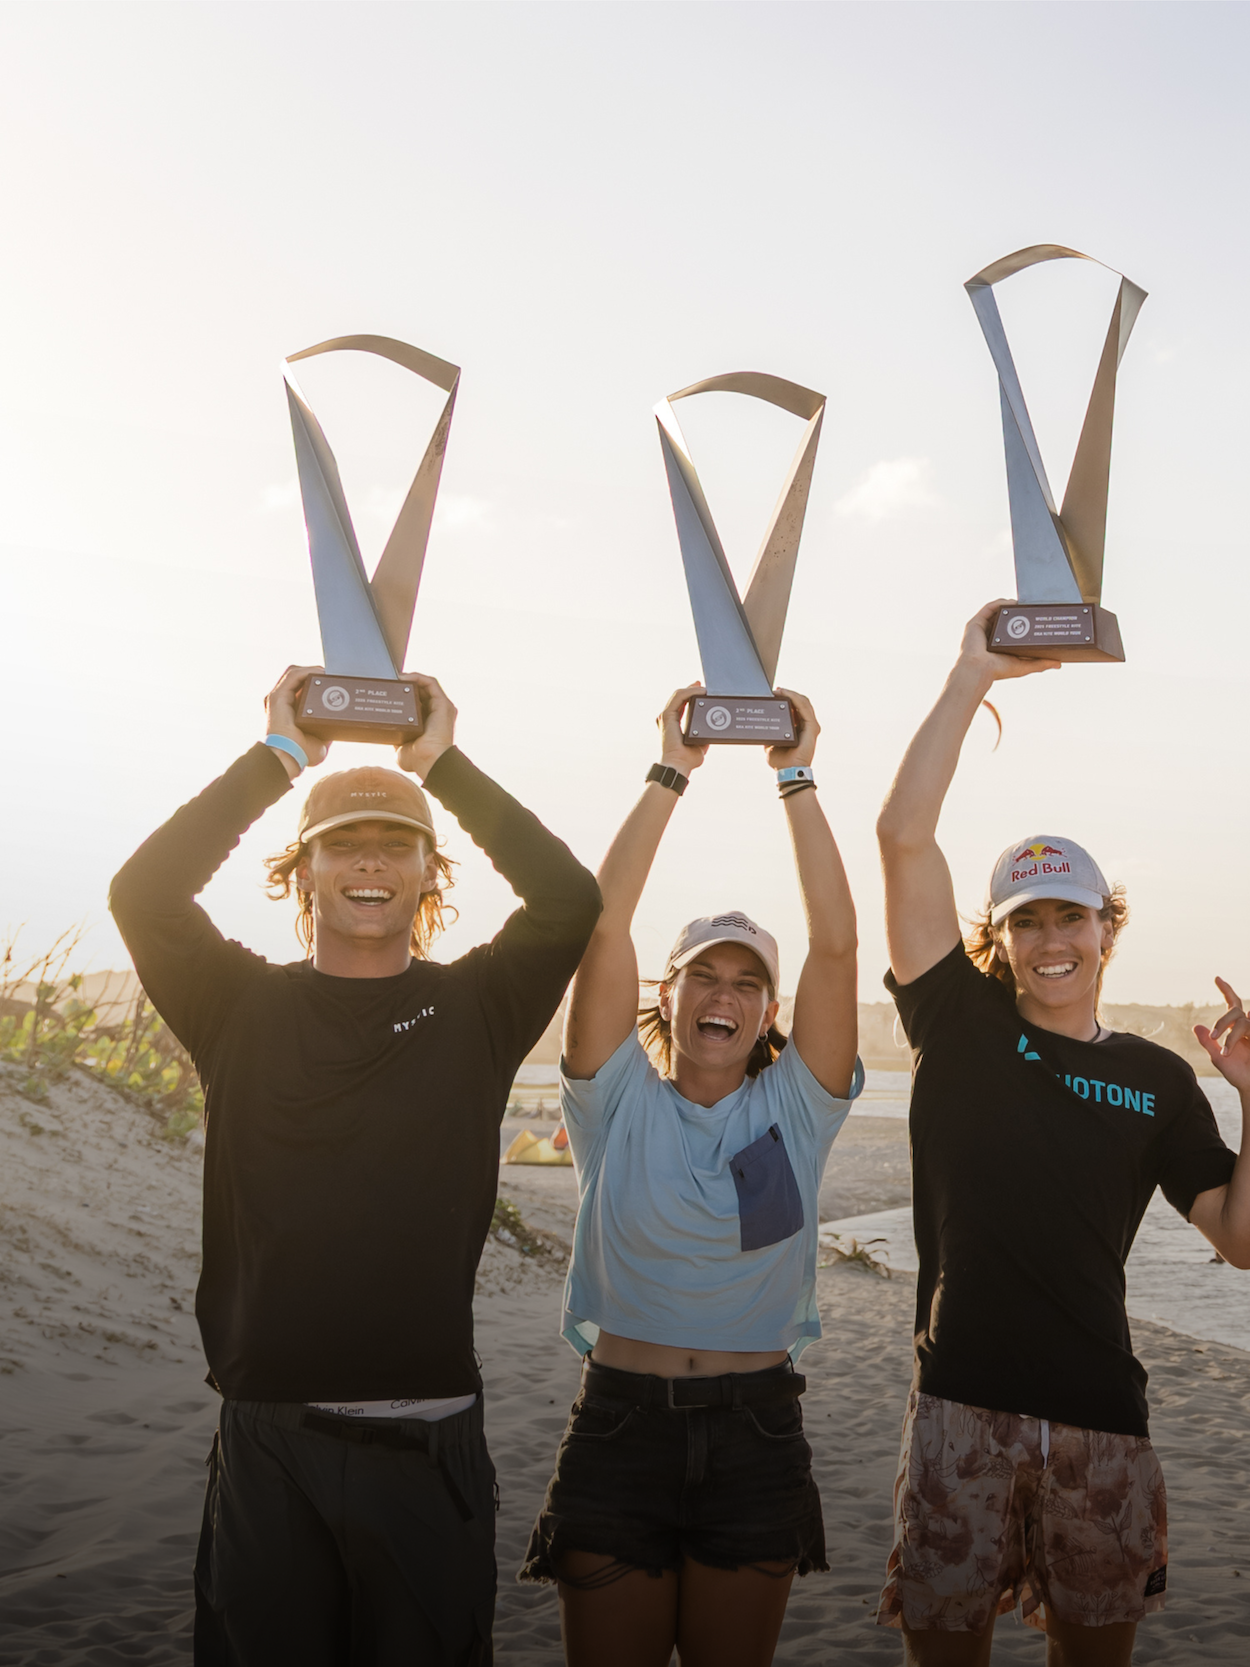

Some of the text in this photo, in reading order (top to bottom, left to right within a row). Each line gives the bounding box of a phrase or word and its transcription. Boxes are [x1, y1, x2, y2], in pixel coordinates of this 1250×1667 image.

[1011, 862, 1070, 882] Red Bull
[1056, 1074, 1156, 1117] OTONE
